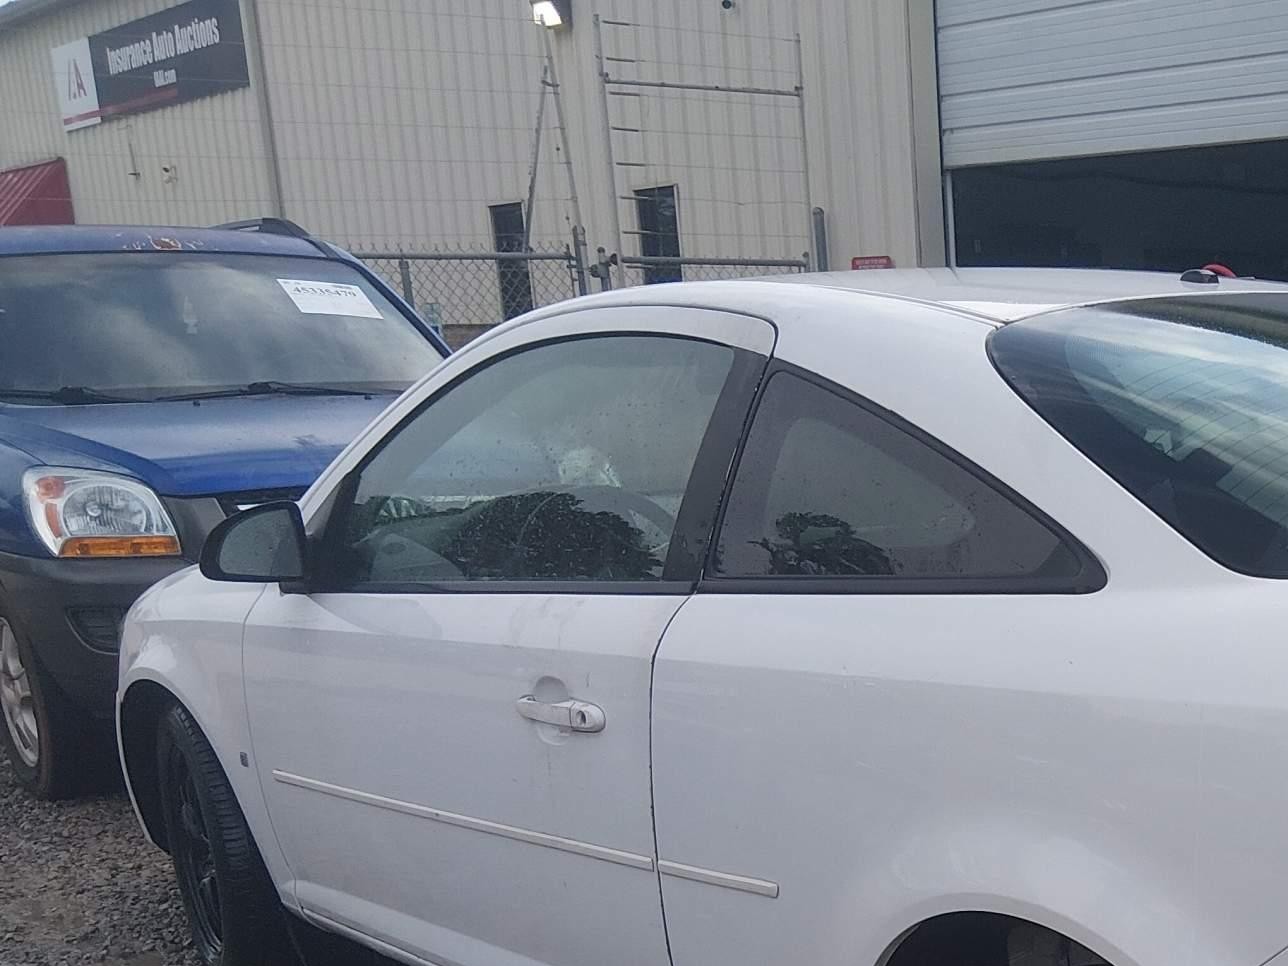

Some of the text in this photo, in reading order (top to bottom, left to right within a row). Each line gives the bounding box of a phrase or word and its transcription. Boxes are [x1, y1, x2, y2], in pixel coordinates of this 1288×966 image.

[107, 17, 220, 75] Insurance Auto Auctions
